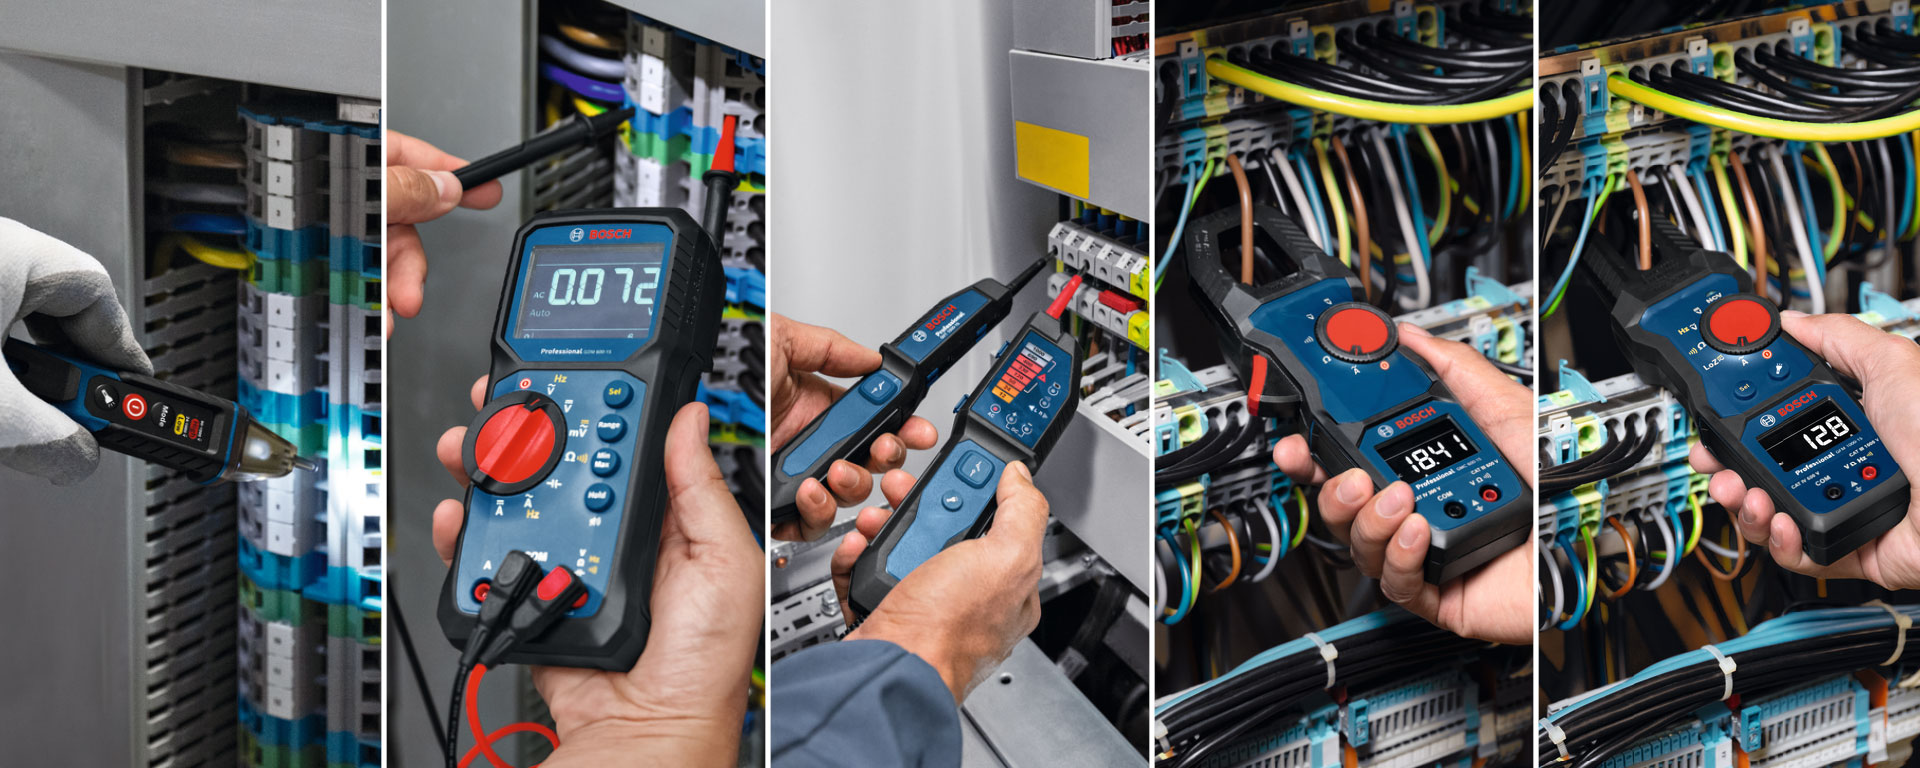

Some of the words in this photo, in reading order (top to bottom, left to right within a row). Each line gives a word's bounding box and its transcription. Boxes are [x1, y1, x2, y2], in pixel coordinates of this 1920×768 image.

[589, 229, 632, 240] BOSCH
[548, 267, 661, 305] 0.072
[533, 291, 545, 299] AC
[1706, 292, 1722, 304] NCV
[530, 309, 550, 317] Auto
[925, 304, 957, 331] BOSCH
[935, 311, 966, 337] Professional
[1678, 327, 1690, 335] Hz
[540, 347, 583, 355] Professional
[1033, 346, 1045, 357] 1000
[554, 374, 567, 383] Hz
[1014, 372, 1024, 380] 120
[608, 387, 622, 395] Sel
[1739, 383, 1750, 392] Sel
[1777, 390, 1818, 417] BOSCH
[159, 404, 169, 427] Mode
[1395, 406, 1437, 430] BOSCH
[176, 416, 184, 432] Low
[598, 421, 621, 429] Range
[1803, 415, 1850, 450] 12.8
[564, 451, 576, 462] Ω
[1405, 434, 1468, 473] 18.41
[1848, 449, 1860, 458] CAT
[1795, 452, 1835, 476] Professional
[1857, 455, 1868, 464] Hz
[1470, 466, 1482, 475] CAT
[1415, 468, 1456, 490] Professional
[1815, 475, 1832, 487] COM
[1791, 481, 1802, 490] CAT
[588, 491, 607, 499] Hold
[1437, 491, 1454, 501] COM
[526, 509, 540, 519] Hz
[483, 560, 492, 570] A
